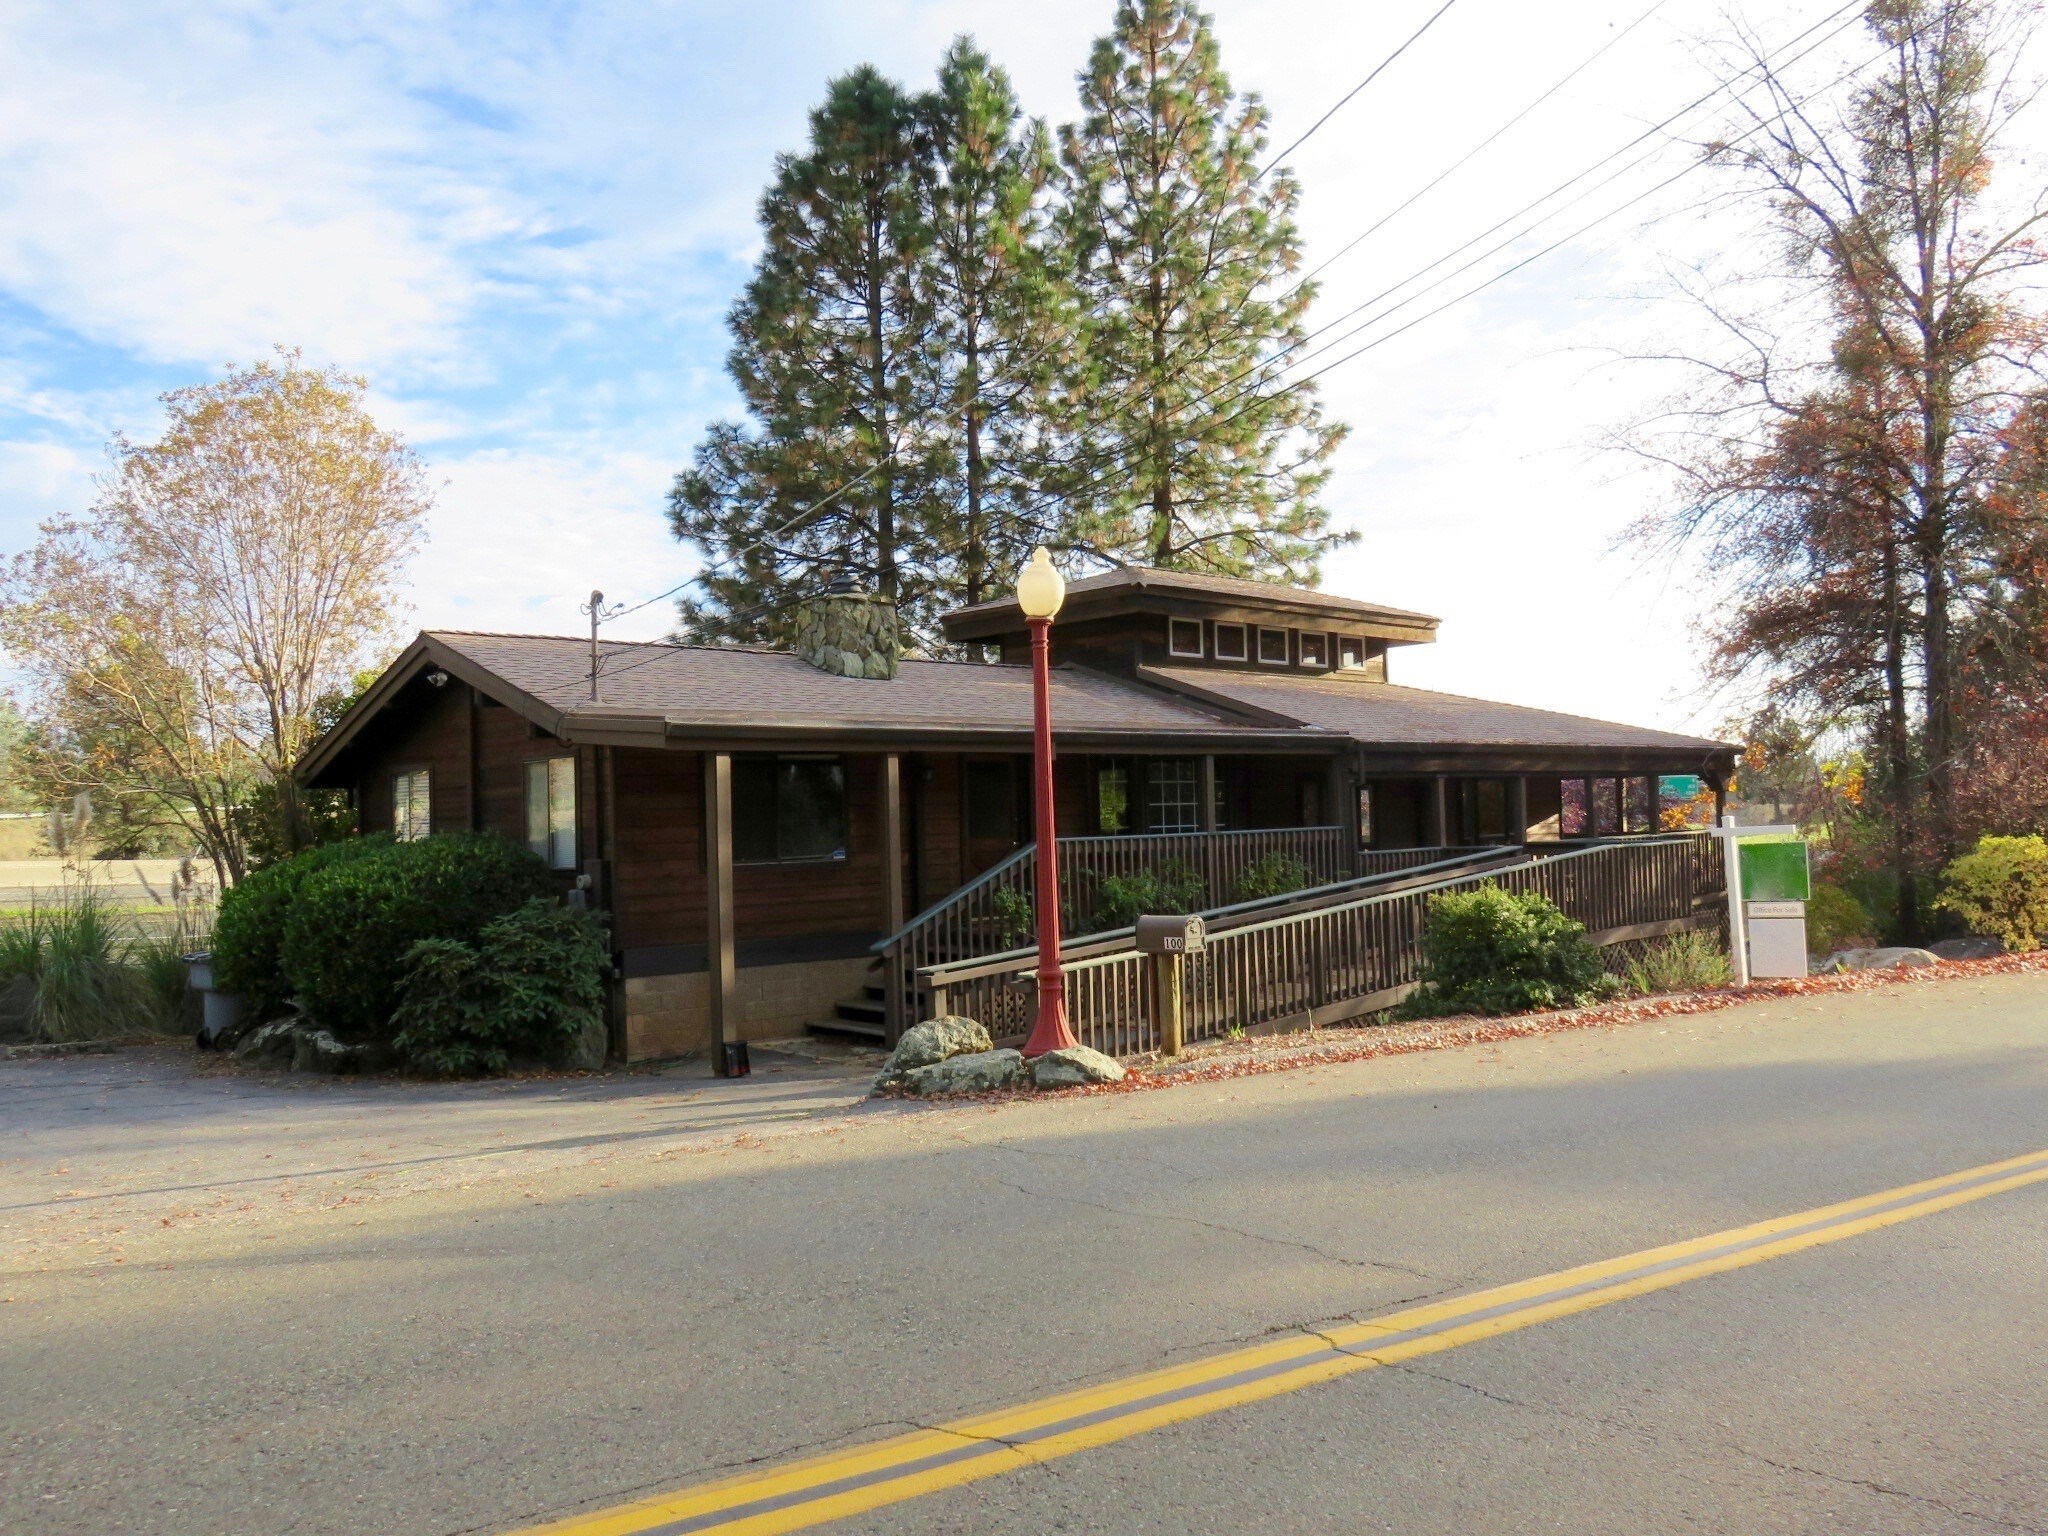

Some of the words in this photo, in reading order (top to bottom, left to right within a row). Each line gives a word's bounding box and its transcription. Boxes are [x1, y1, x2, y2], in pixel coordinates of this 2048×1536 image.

[1753, 906, 1771, 914] Office
[1773, 906, 1782, 914] For
[1785, 906, 1798, 914] Sale
[1166, 938, 1183, 949] 100
